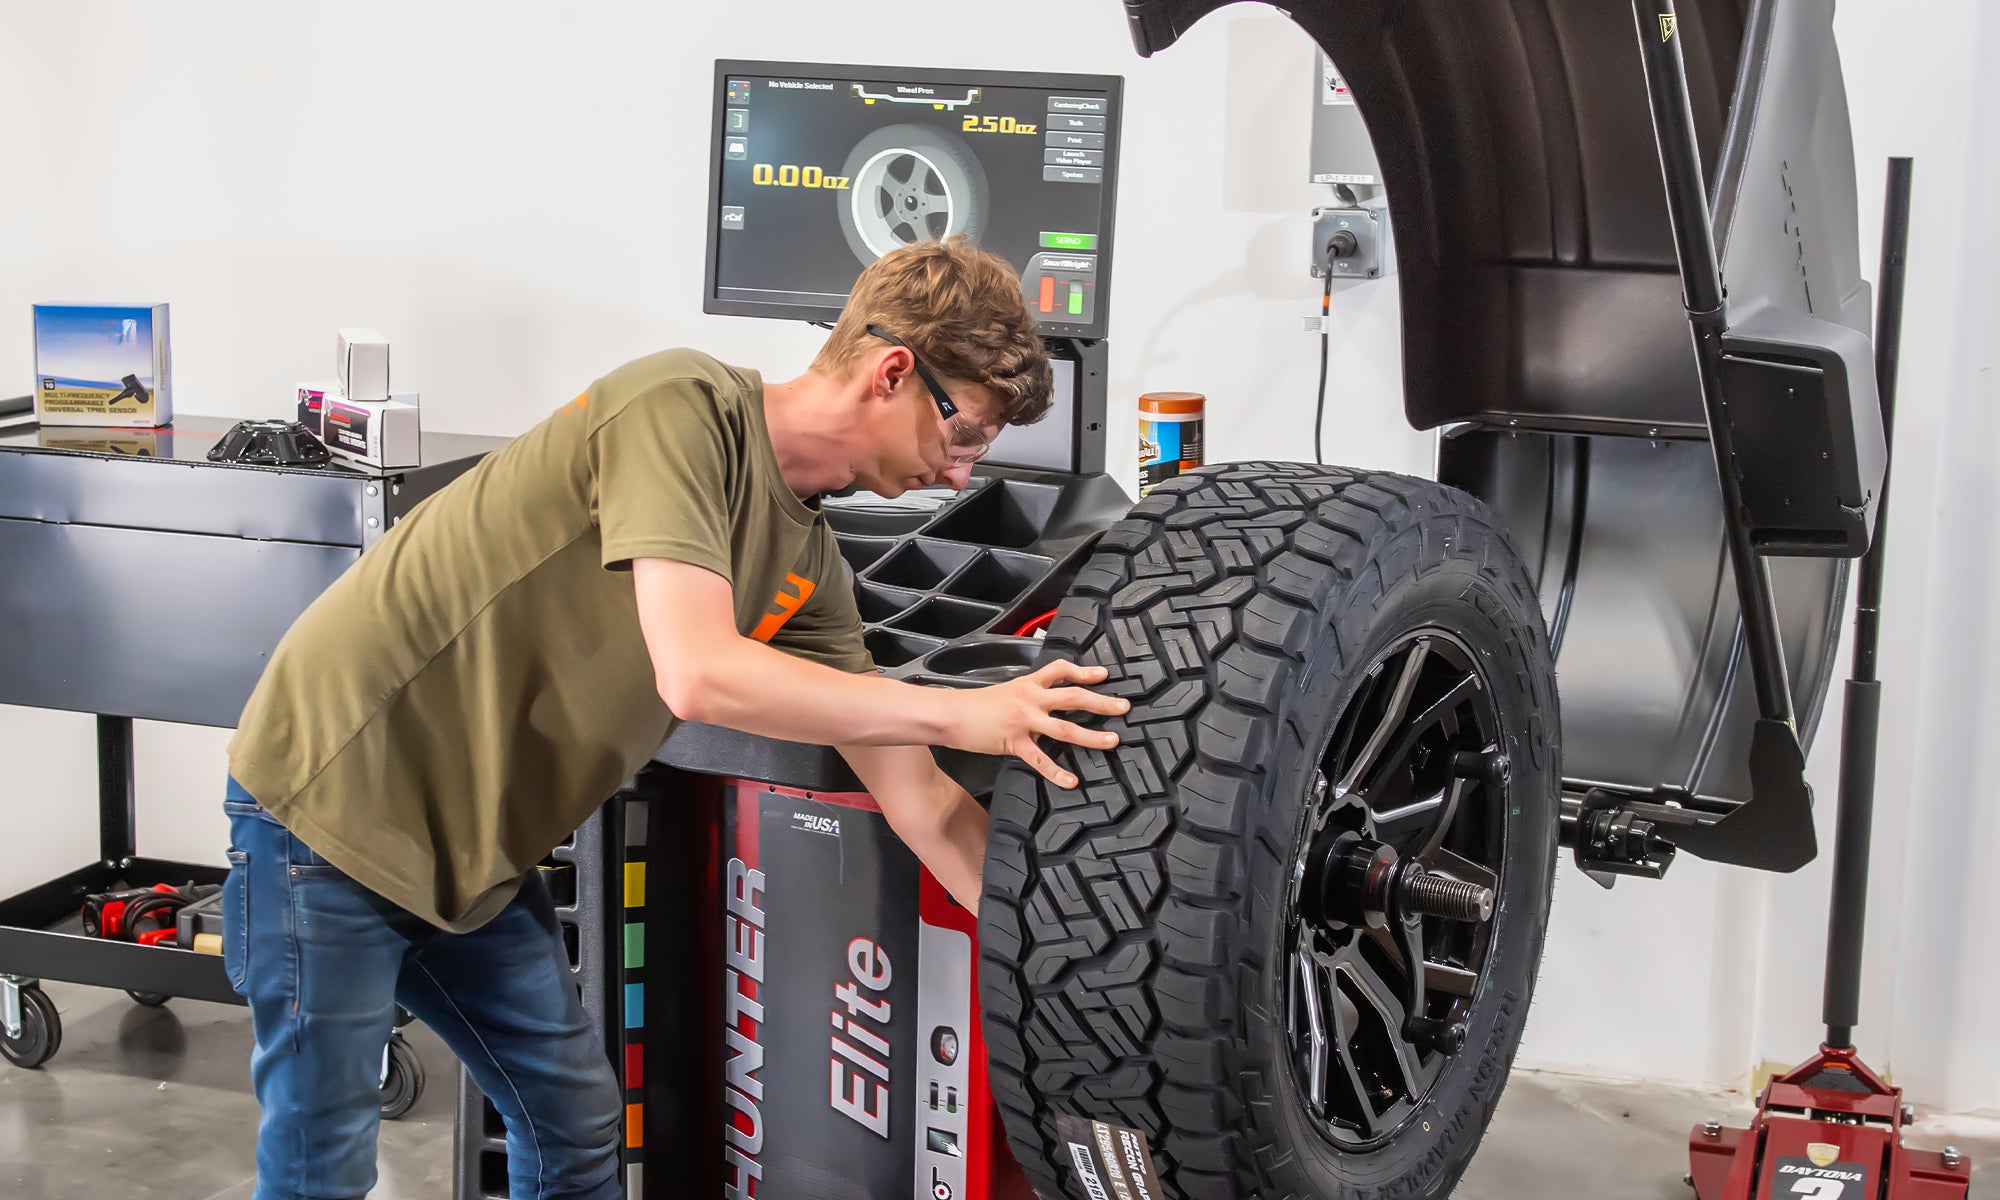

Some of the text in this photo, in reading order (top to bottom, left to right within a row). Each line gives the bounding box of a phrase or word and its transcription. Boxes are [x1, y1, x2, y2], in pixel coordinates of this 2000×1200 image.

[779, 81, 803, 89] Vehicle
[804, 82, 833, 90] Selected
[897, 86, 934, 95] Wheel Pros
[1068, 119, 1084, 127] Tools
[1067, 136, 1083, 144] Print
[1073, 158, 1092, 166] Player
[1056, 236, 1081, 245] SERVO
[793, 812, 815, 822] MADE
[812, 816, 840, 834] USA
[725, 857, 766, 1200] HUNTER
[831, 936, 893, 1140] Elite
[1118, 1130, 1140, 1171] RECON
[1779, 1165, 1862, 1181] DAYTONA
